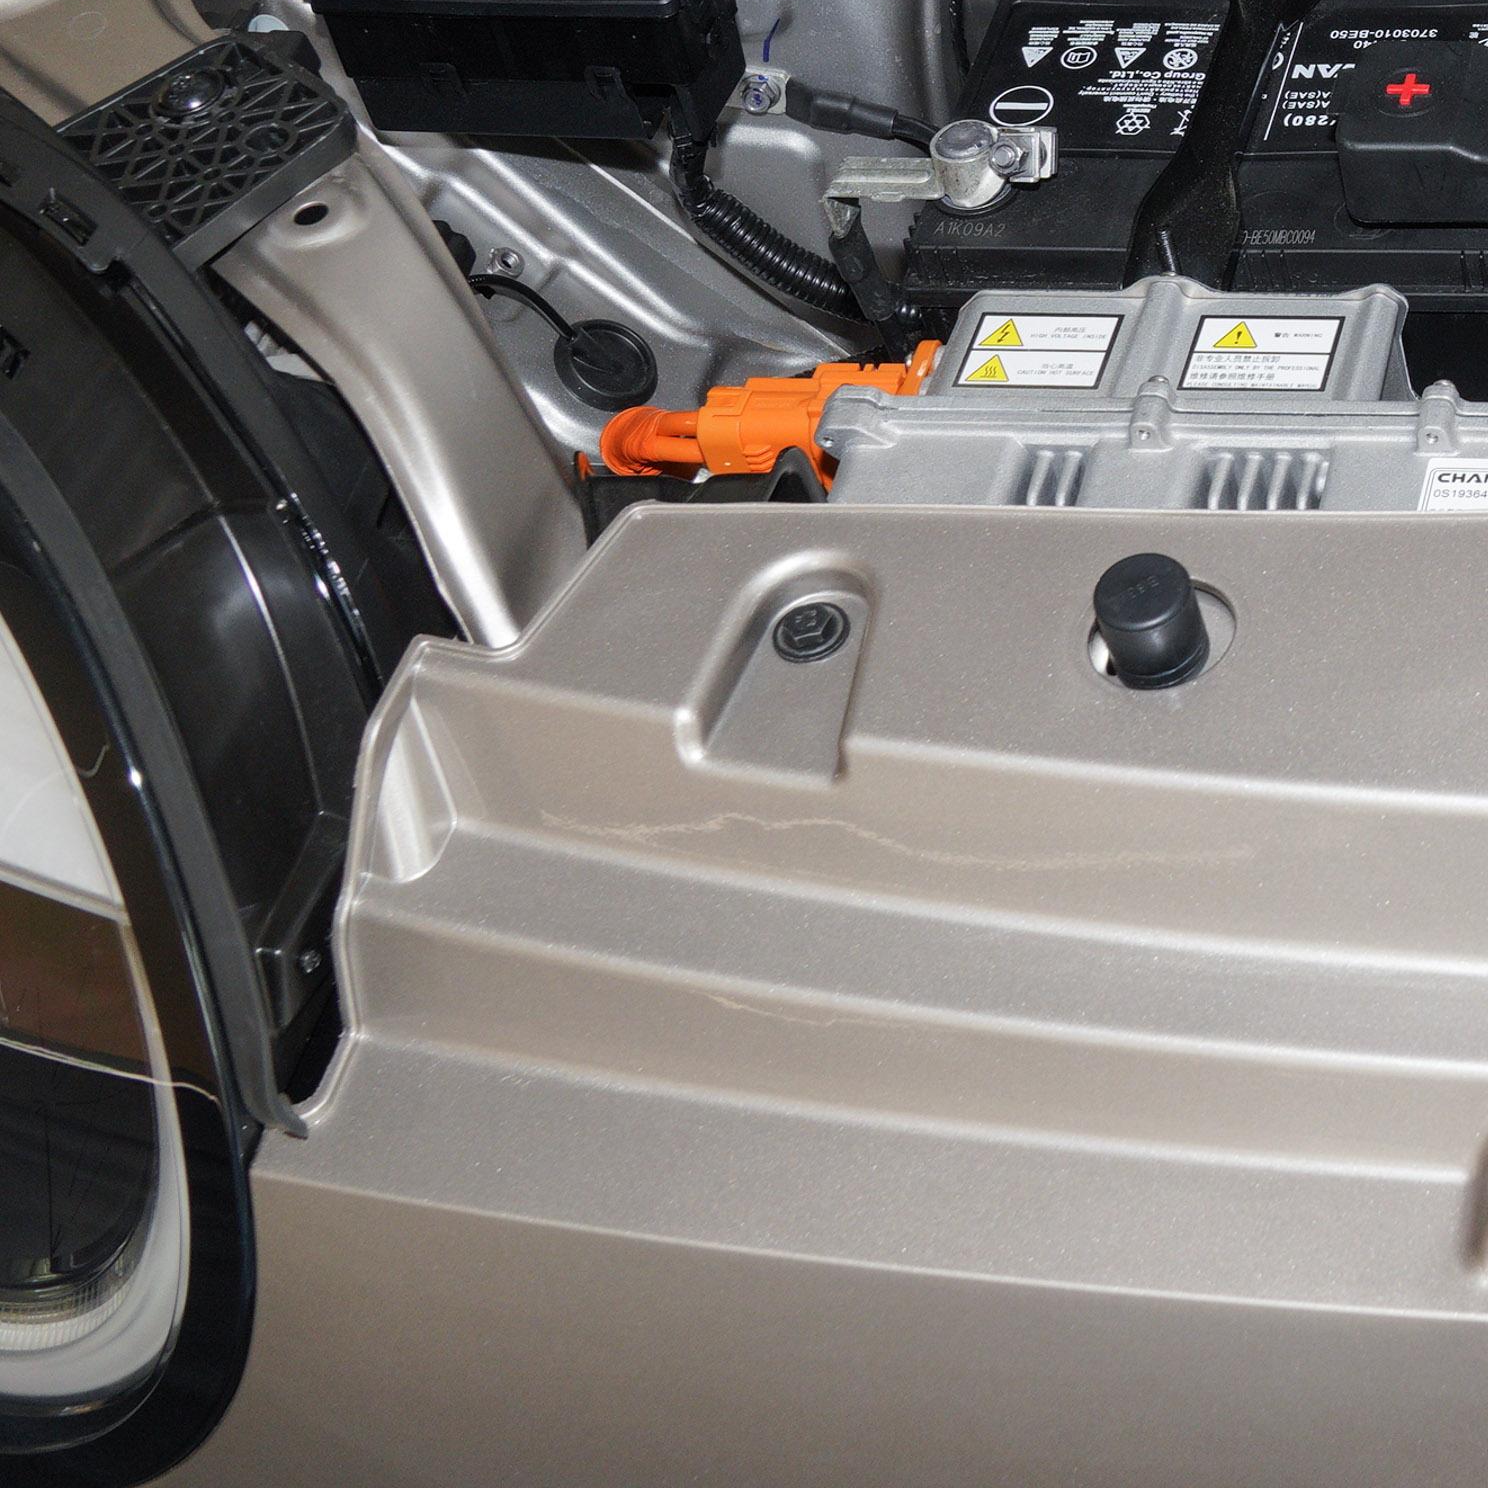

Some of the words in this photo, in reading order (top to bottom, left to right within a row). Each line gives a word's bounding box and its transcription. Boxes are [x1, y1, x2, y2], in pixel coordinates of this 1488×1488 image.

[1330, 29, 1438, 39] 3703010-BE50
[1164, 72, 1206, 80] Group
[1433, 489, 1488, 498] 0S19364
